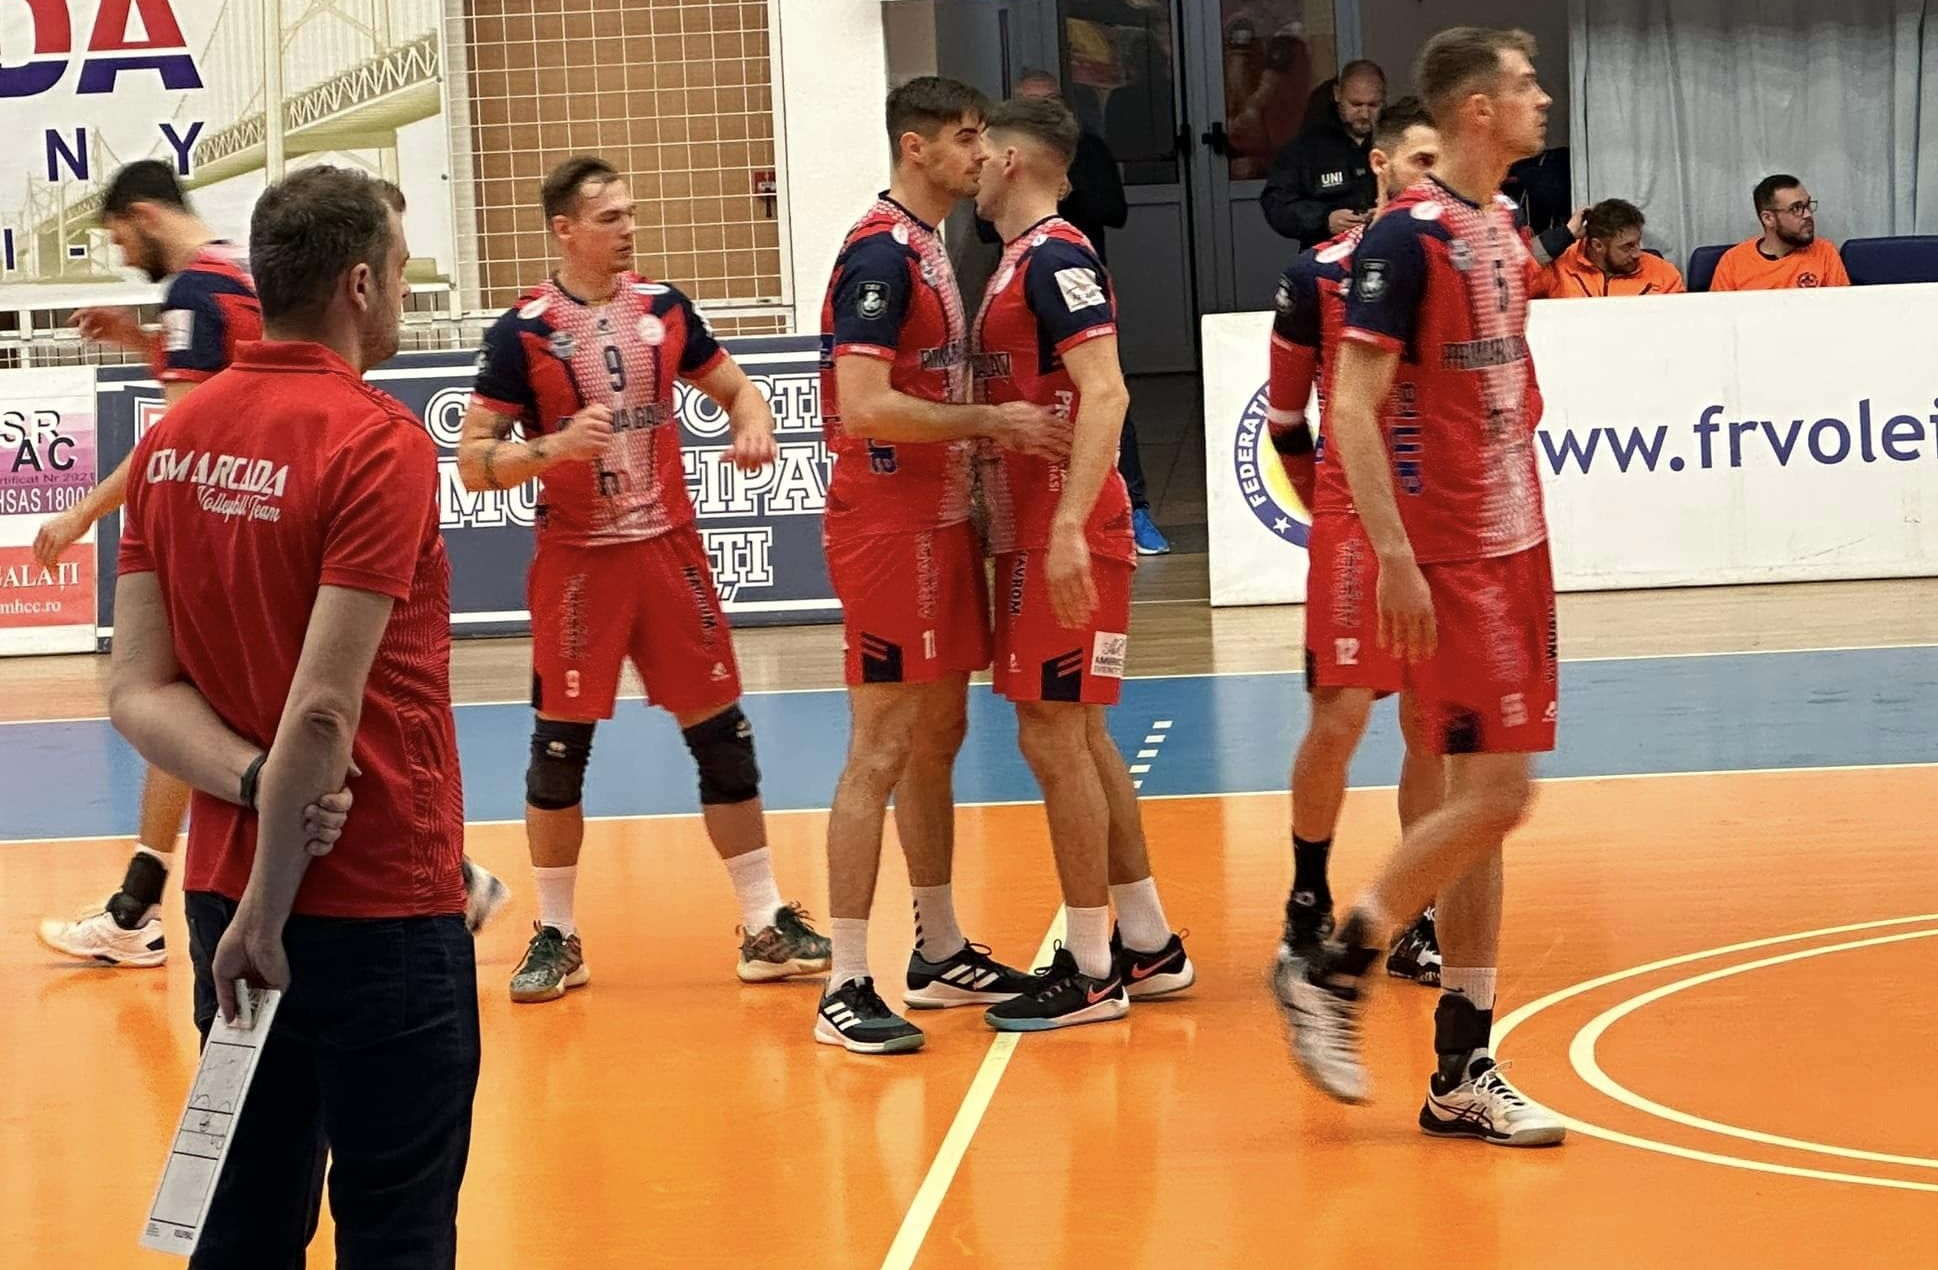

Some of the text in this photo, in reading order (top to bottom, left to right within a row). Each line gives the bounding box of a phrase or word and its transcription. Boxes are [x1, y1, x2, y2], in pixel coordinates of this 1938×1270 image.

[1321, 171, 1343, 185] UNI
[604, 345, 627, 393] 9
[11, 435, 76, 473] AC
[46, 486, 93, 511] 1800
[0, 562, 80, 593] ALAȚI
